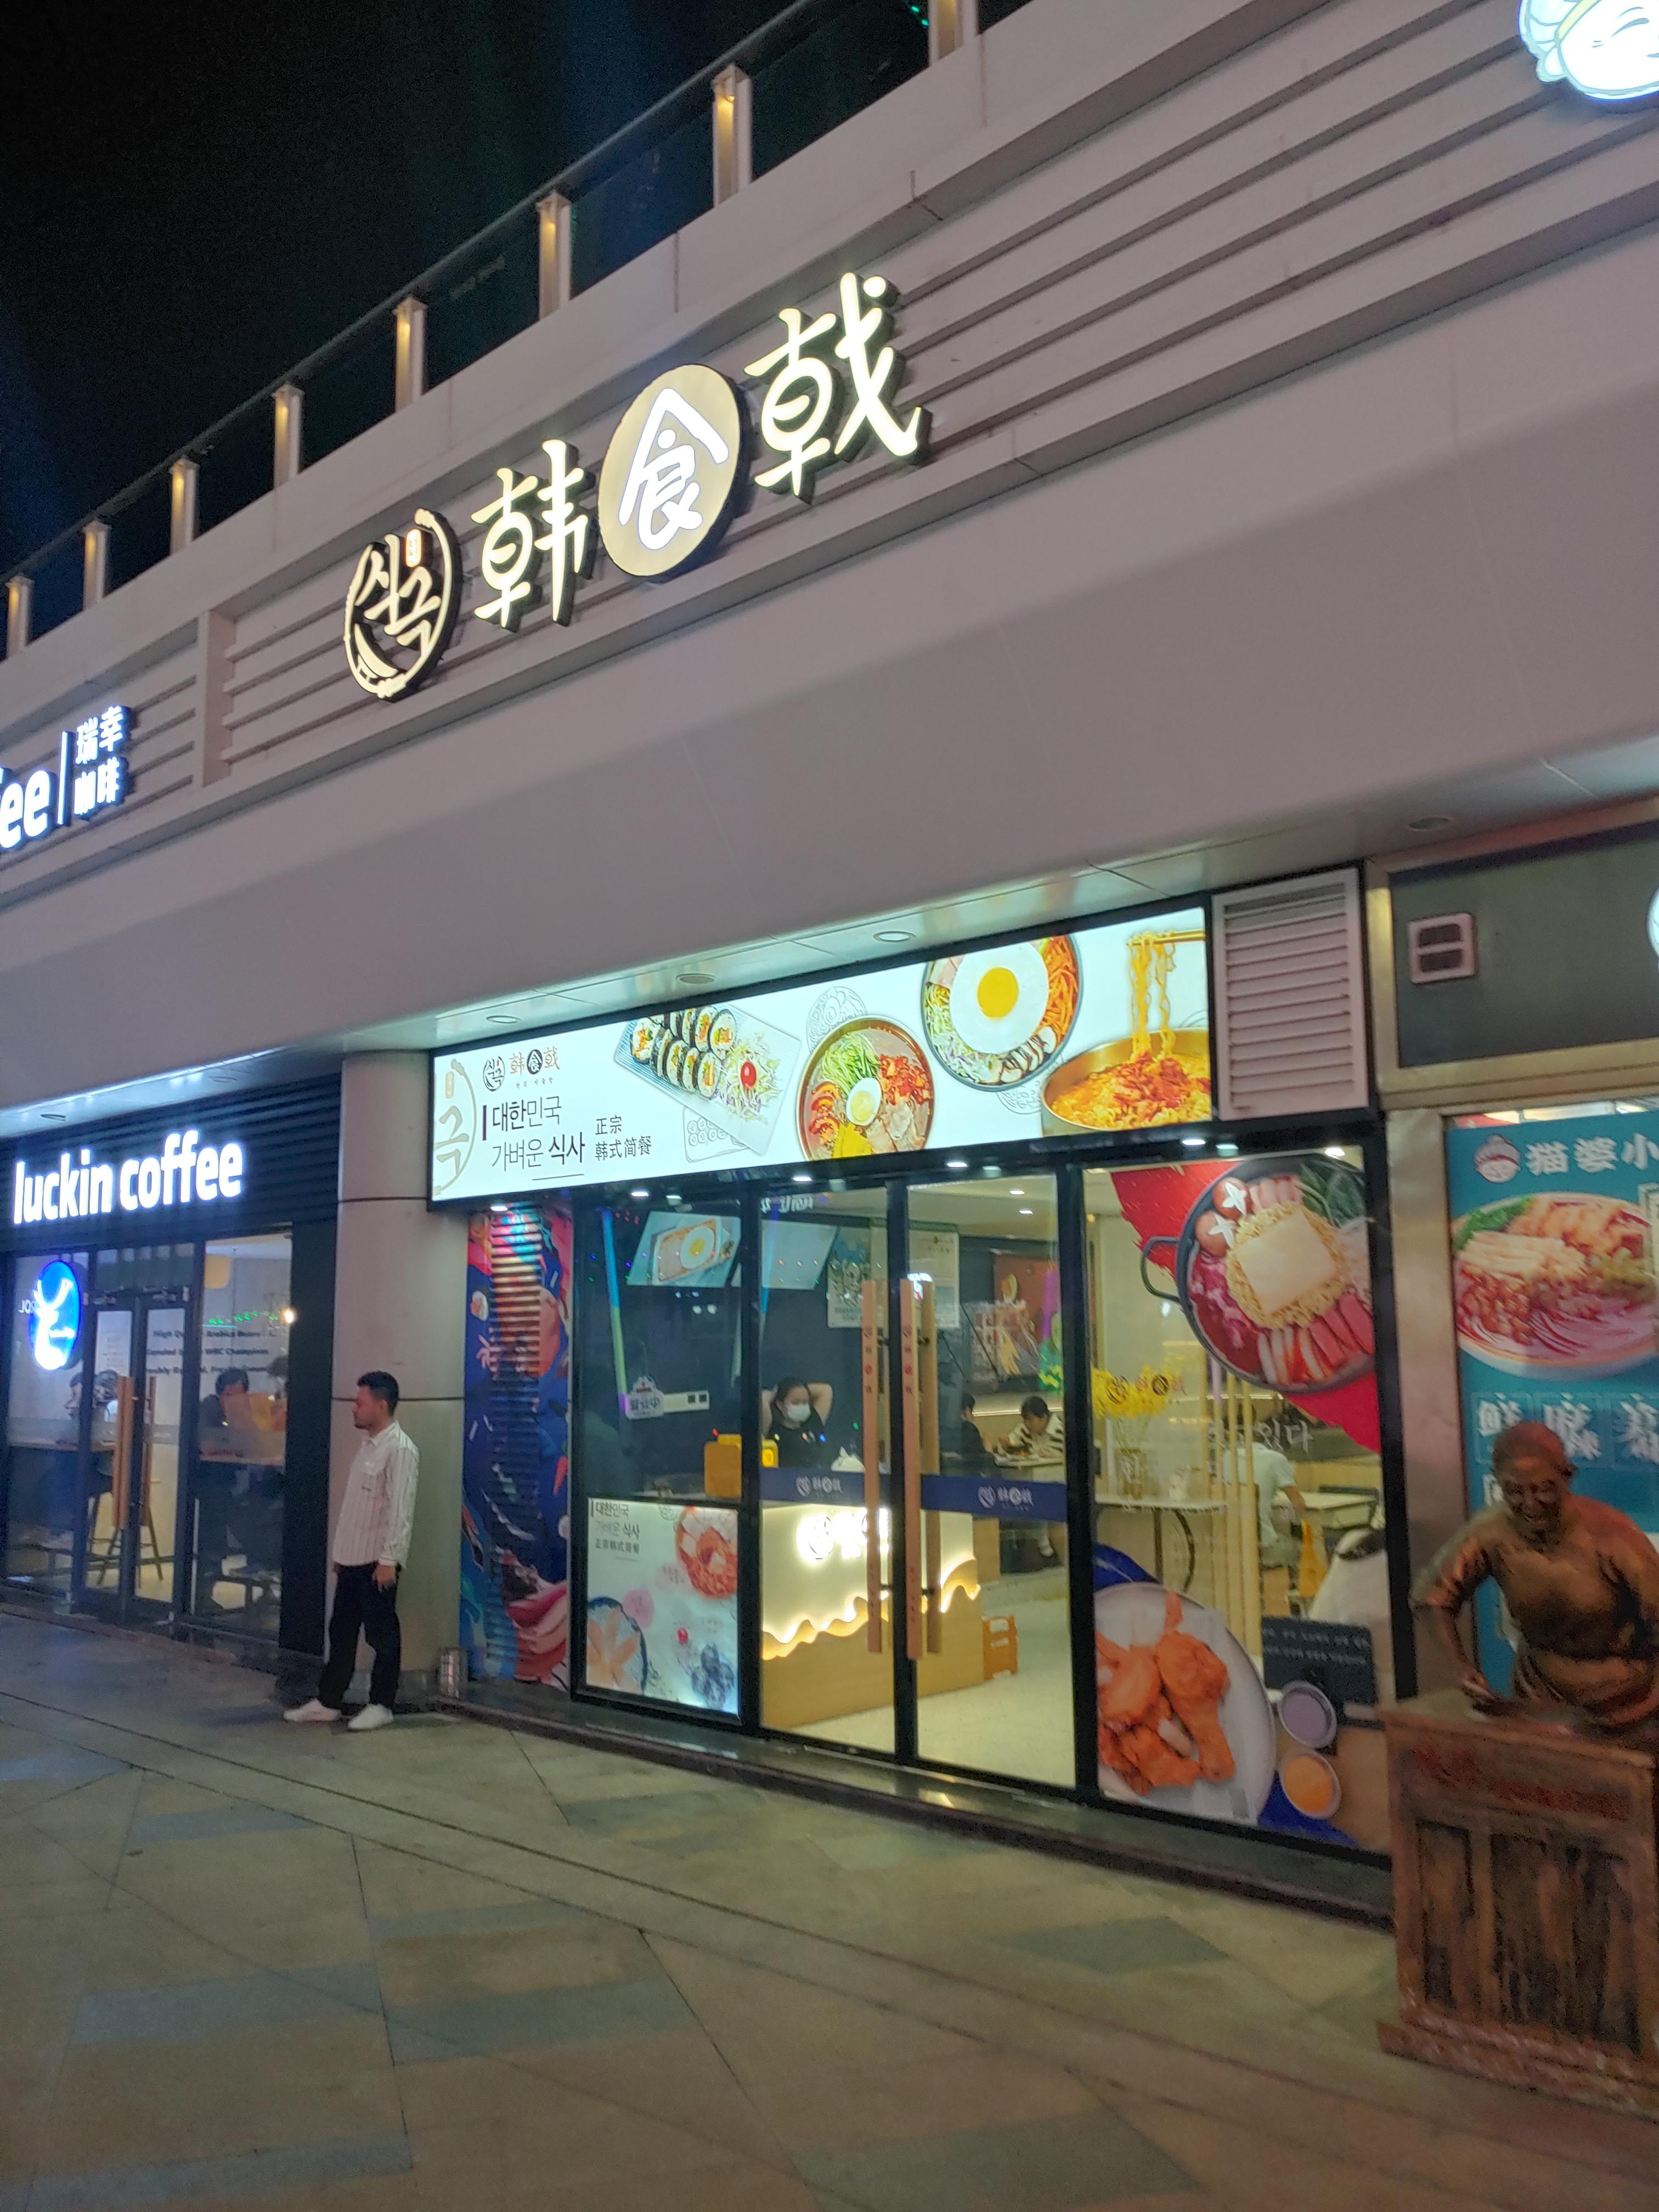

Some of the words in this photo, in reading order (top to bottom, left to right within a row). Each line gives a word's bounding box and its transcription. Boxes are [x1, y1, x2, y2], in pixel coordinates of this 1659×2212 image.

[75, 705, 123, 764] 瑞幸
[0, 766, 50, 848] ee
[492, 1096, 562, 1132] 대한민국
[595, 1115, 622, 1136] 正宗
[491, 1138, 545, 1171] 가벼운
[549, 1131, 586, 1165] 식사
[595, 1135, 652, 1161] 韩式简餐
[14, 1148, 112, 1224] luckin
[119, 1129, 244, 1211] coffee
